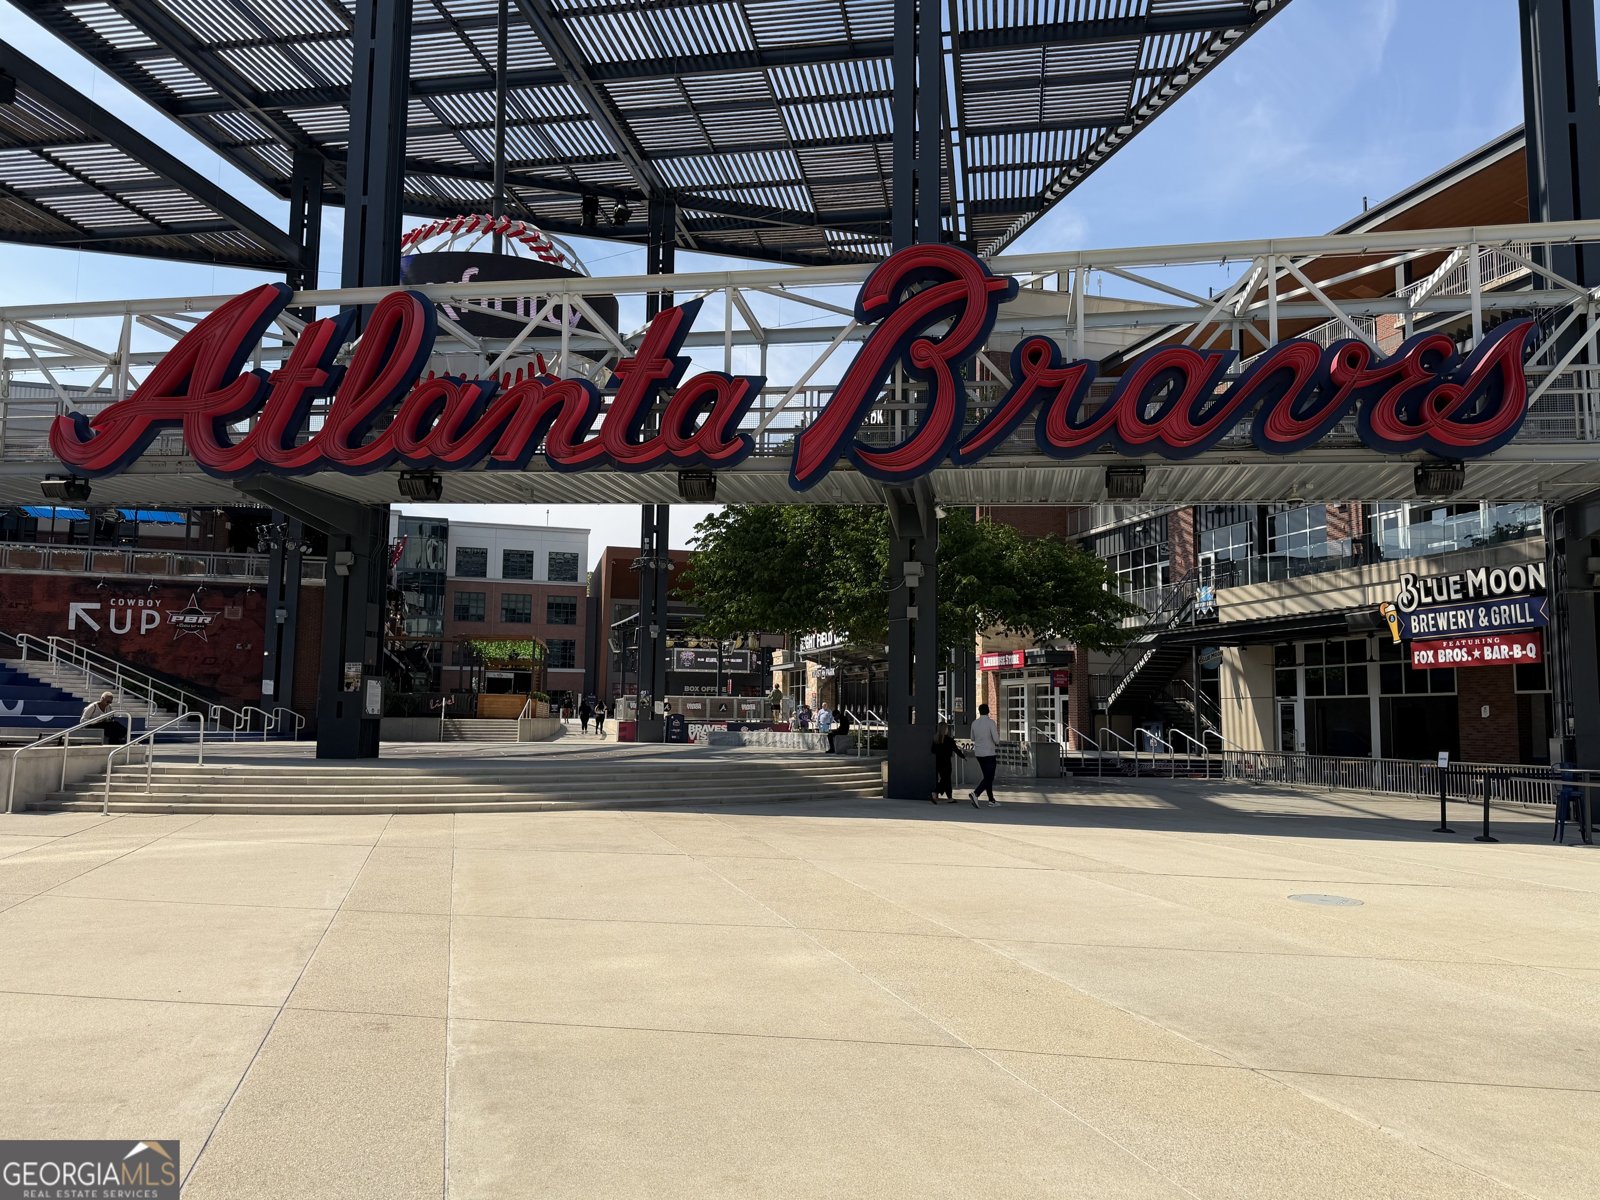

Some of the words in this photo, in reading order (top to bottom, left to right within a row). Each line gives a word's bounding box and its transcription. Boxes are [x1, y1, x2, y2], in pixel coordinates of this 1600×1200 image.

[50, 282, 768, 478] Atlanta
[790, 242, 1538, 491] Braves
[1397, 573, 1464, 613] BLUE
[1465, 562, 1547, 598] MOON
[110, 598, 162, 607] COWBOY
[109, 608, 161, 635] UP
[170, 615, 212, 624] PBR
[1410, 608, 1475, 634] BREWERY
[1478, 606, 1489, 628] &
[1491, 602, 1535, 626] GRILL
[1414, 650, 1435, 665] FOX
[1438, 647, 1472, 664] BROS.
[1483, 643, 1537, 661] BAR-B-Q
[1443, 637, 1501, 647] FEATURING
[1107, 671, 1135, 705] BRIGHTER
[1133, 649, 1152, 673] TIMES
[688, 724, 728, 733] BRAVES
